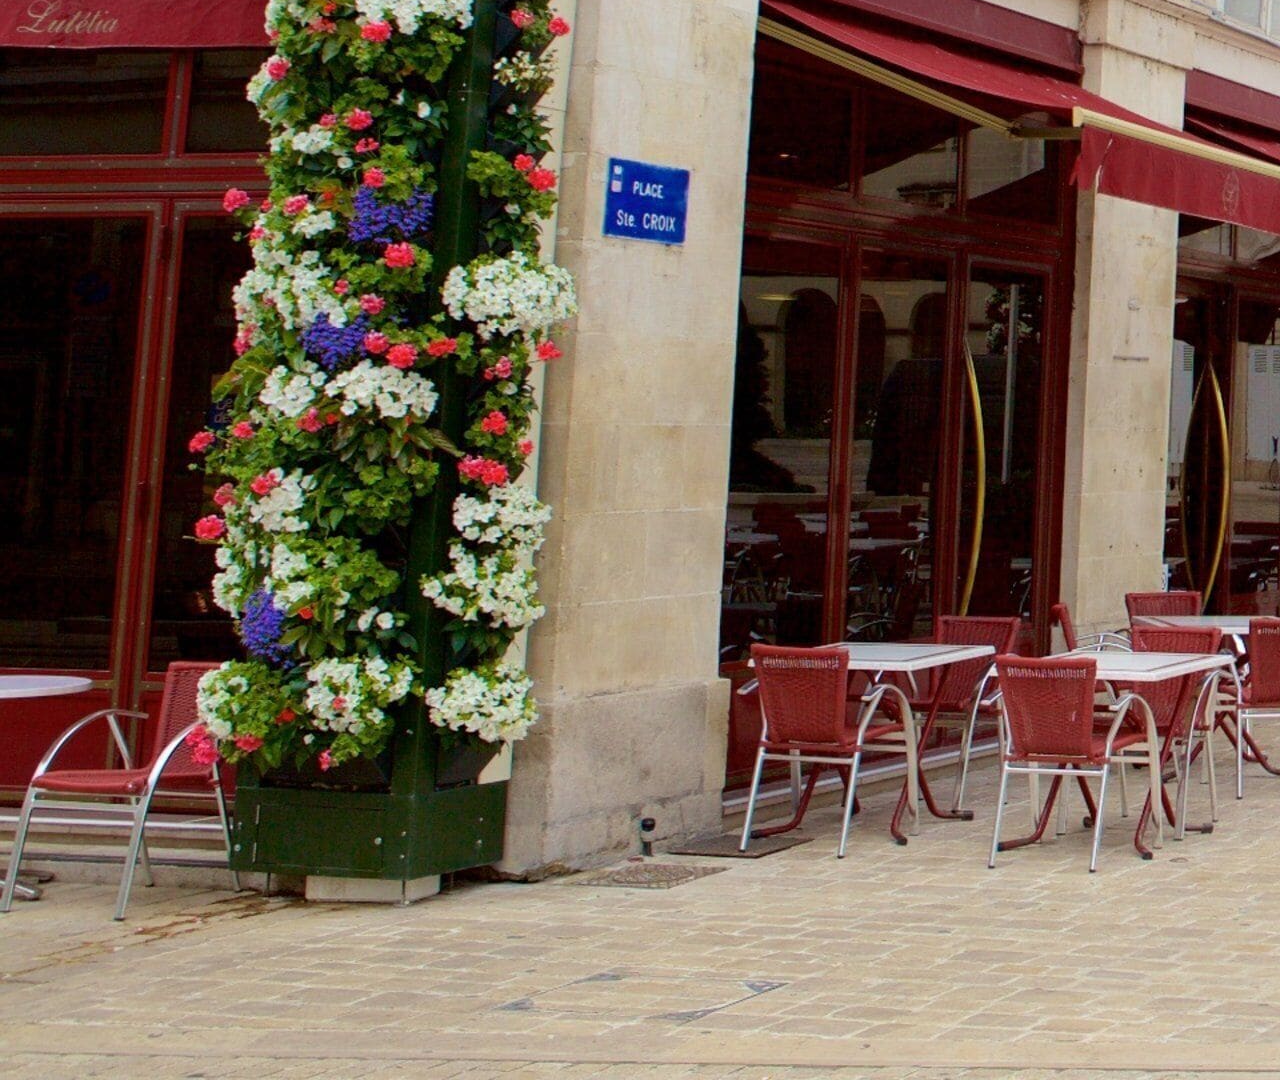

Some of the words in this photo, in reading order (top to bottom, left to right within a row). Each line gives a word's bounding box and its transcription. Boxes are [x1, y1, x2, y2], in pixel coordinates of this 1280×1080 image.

[16, 0, 119, 34] Lutétia
[632, 180, 664, 199] PLACE
[642, 212, 676, 232] CROIX
